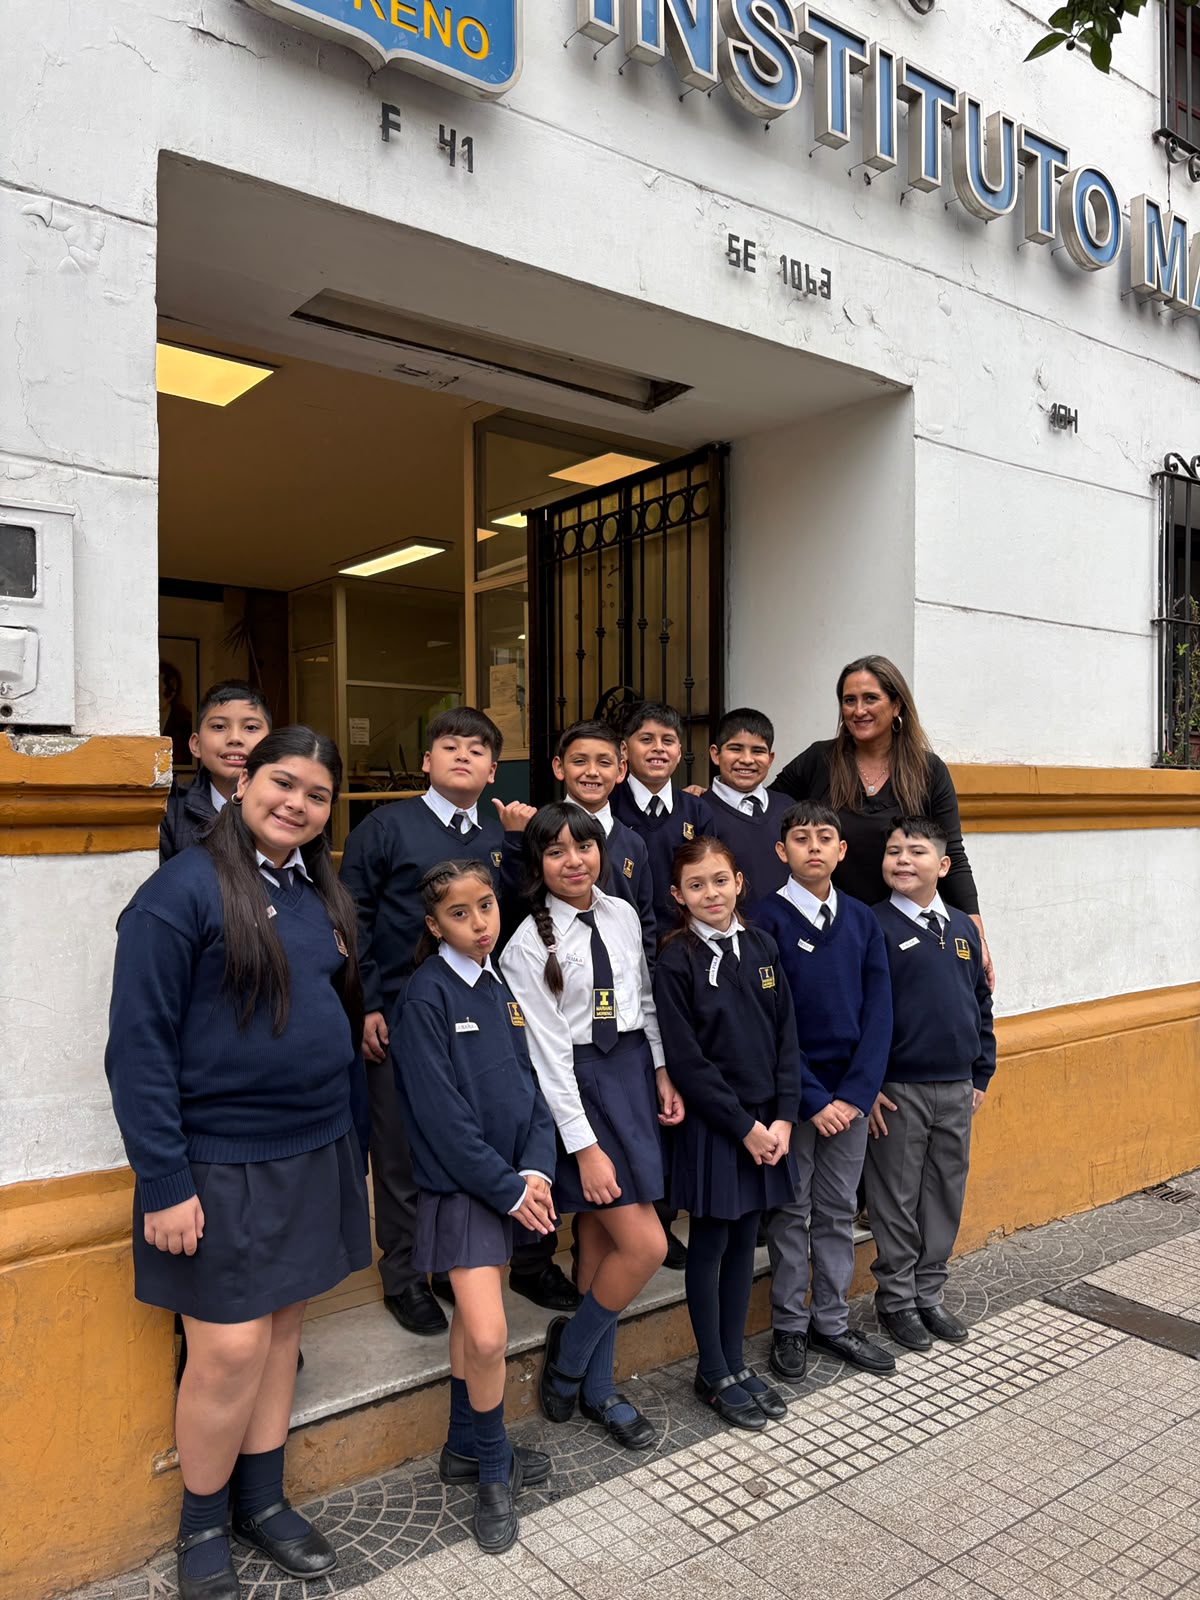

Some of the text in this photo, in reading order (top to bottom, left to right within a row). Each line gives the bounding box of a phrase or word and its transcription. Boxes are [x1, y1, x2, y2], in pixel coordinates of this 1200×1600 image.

[381, 102, 475, 173] F 41
[577, 0, 1200, 316] NSTITUTO M
[727, 233, 832, 300] SE 1063
